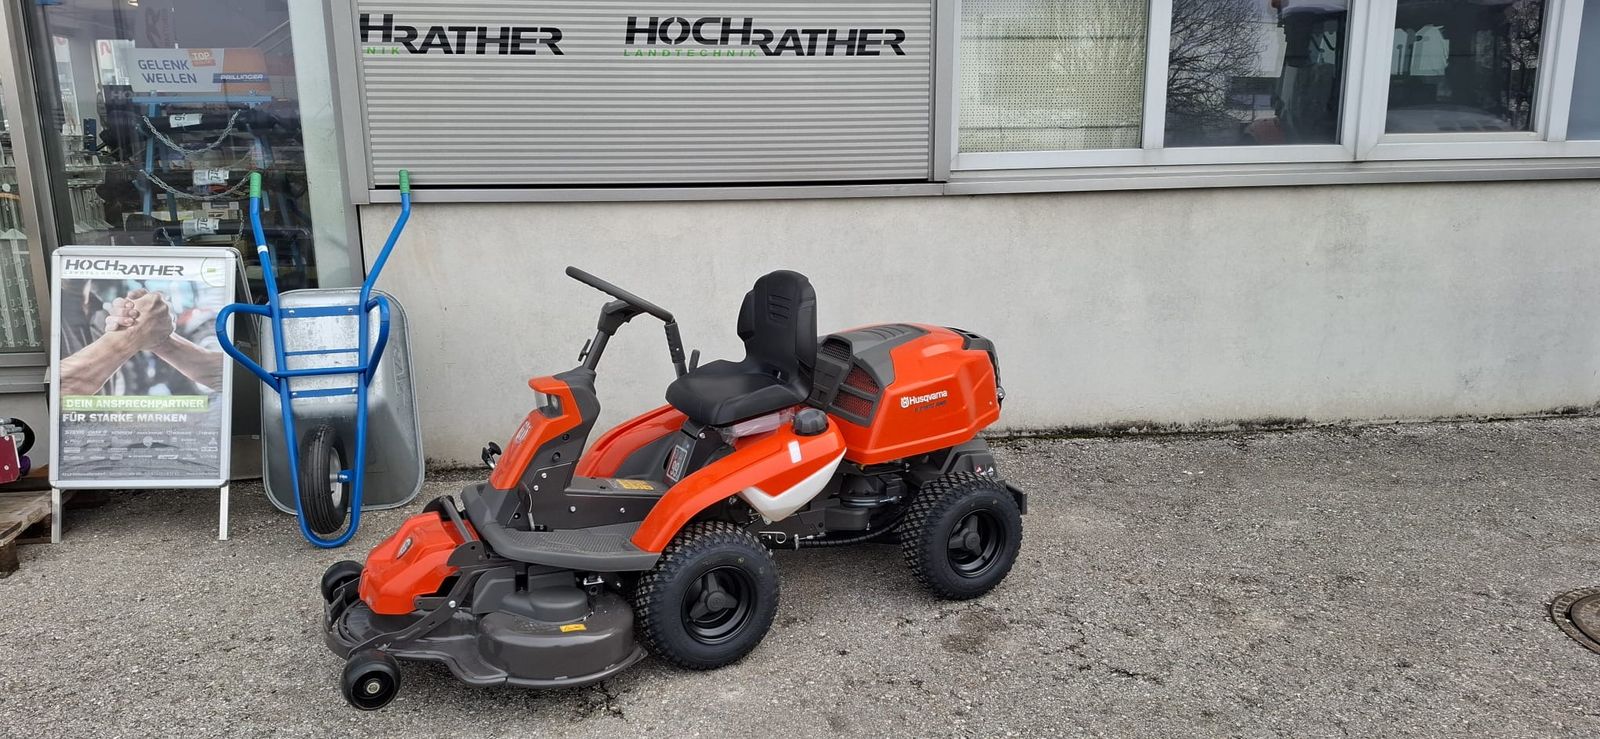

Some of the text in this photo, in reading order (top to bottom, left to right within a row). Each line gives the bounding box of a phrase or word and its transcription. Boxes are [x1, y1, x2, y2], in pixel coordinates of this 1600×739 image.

[624, 16, 907, 57] HOCHRATHER
[191, 52, 210, 61] TOP
[623, 48, 758, 57] LANDTECHNIK
[138, 59, 190, 71] GELENK
[141, 73, 198, 84] WELLEN
[65, 258, 185, 277] HOCHRATHER
[909, 390, 947, 404] Husqvarna
[65, 399, 205, 409] DEIN ANSPRECHPARTNER
[62, 411, 188, 423] FÜR STARKE MARKEN
